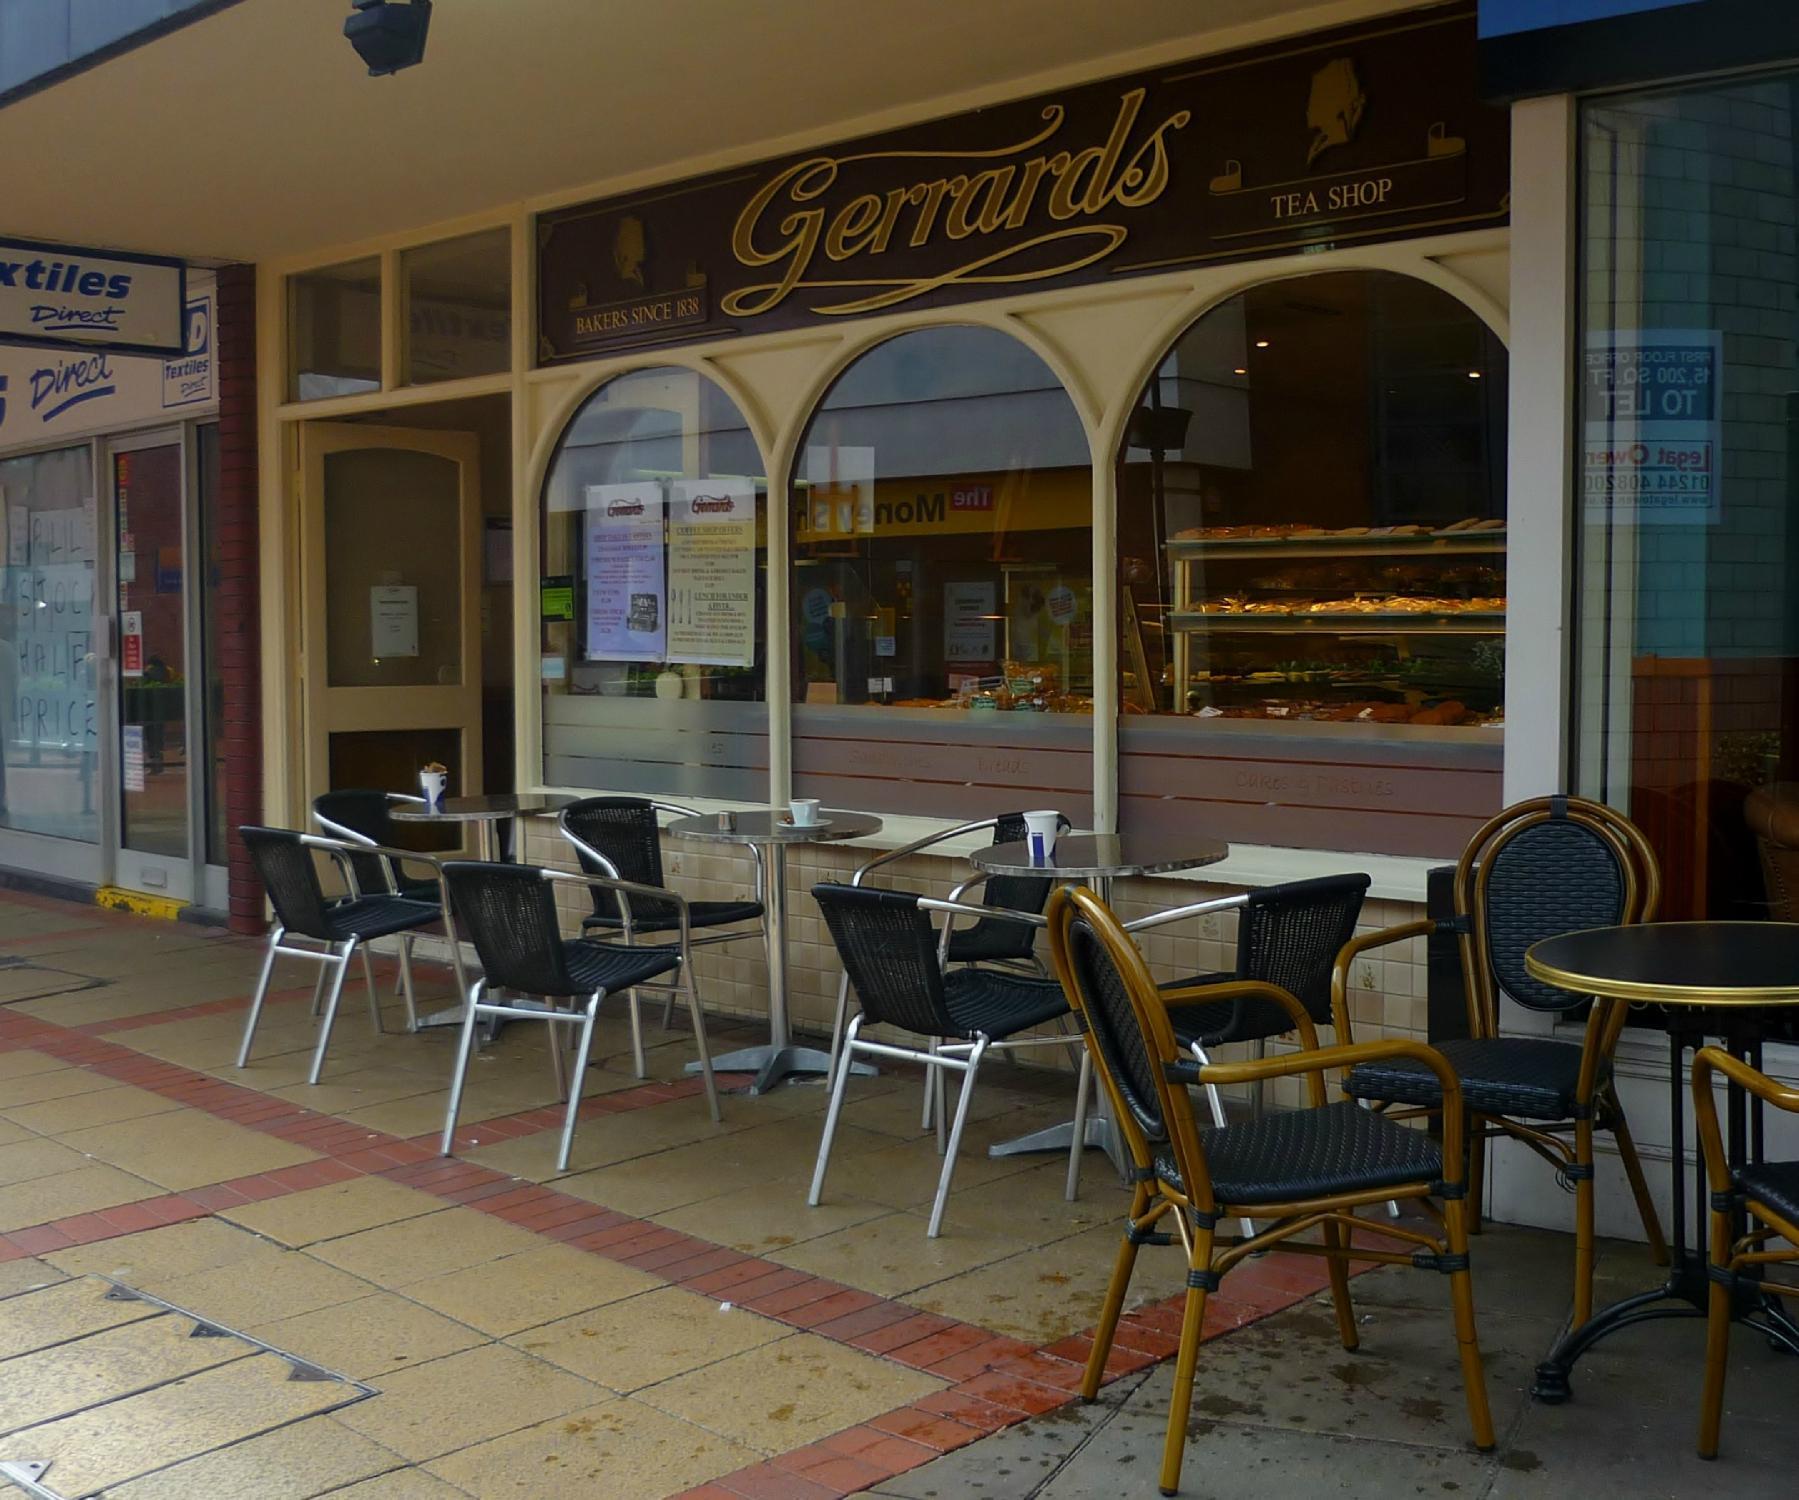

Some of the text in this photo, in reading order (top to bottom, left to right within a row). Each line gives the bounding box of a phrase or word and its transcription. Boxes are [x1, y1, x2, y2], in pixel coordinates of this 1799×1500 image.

[720, 88, 1191, 317] Gerrards
[1271, 178, 1392, 218] TEA SHOP
[30, 305, 125, 325] Direct
[576, 297, 700, 335] BAKERS SINCE 1838
[165, 359, 209, 380] Textiles
[20, 639, 84, 681] HALF
[21, 696, 97, 737] PRICE
